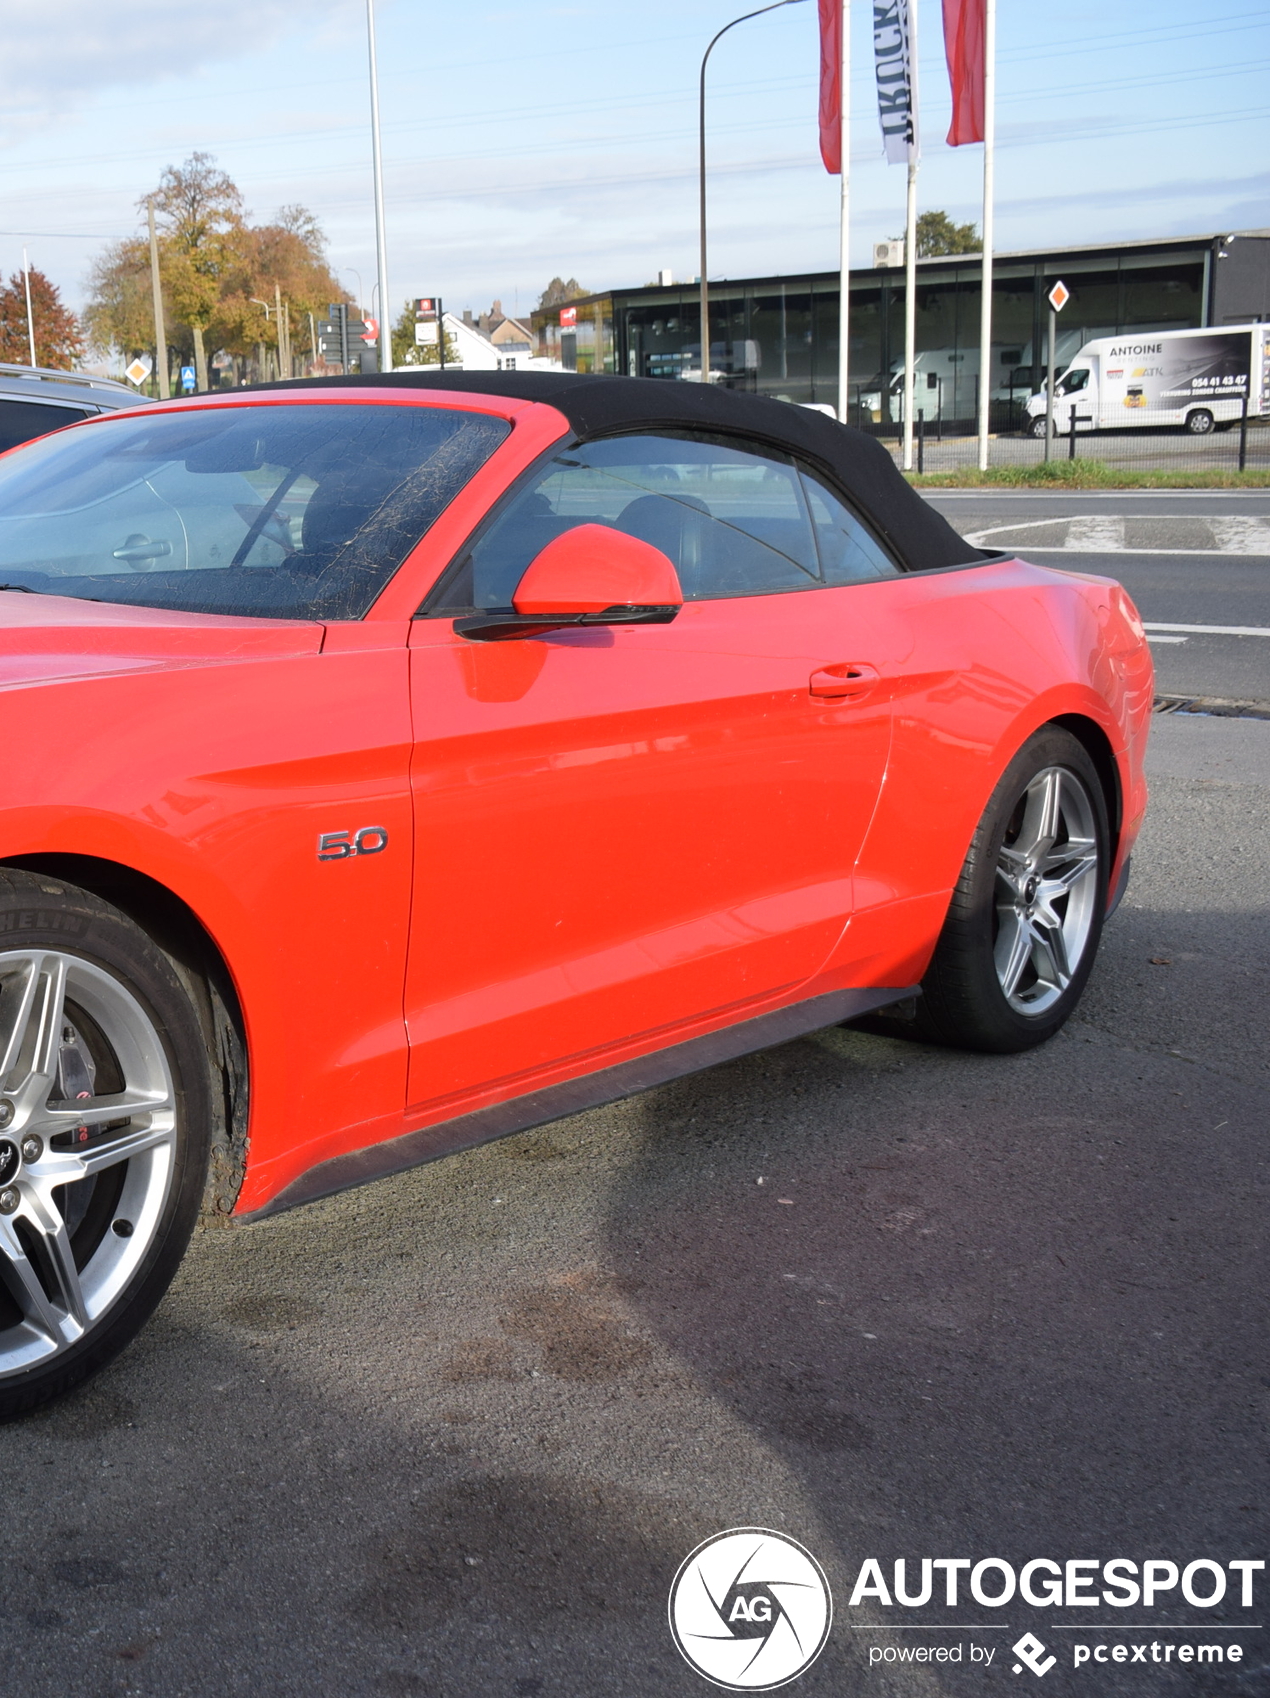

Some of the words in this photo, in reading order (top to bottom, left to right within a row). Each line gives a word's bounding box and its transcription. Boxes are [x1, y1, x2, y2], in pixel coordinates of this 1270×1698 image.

[1109, 343, 1163, 357] ANTOINE
[1192, 378, 1208, 387] 054
[1210, 377, 1220, 386] 41
[1222, 376, 1234, 385] 43
[1235, 375, 1247, 384] 47
[317, 825, 388, 862] 5.0
